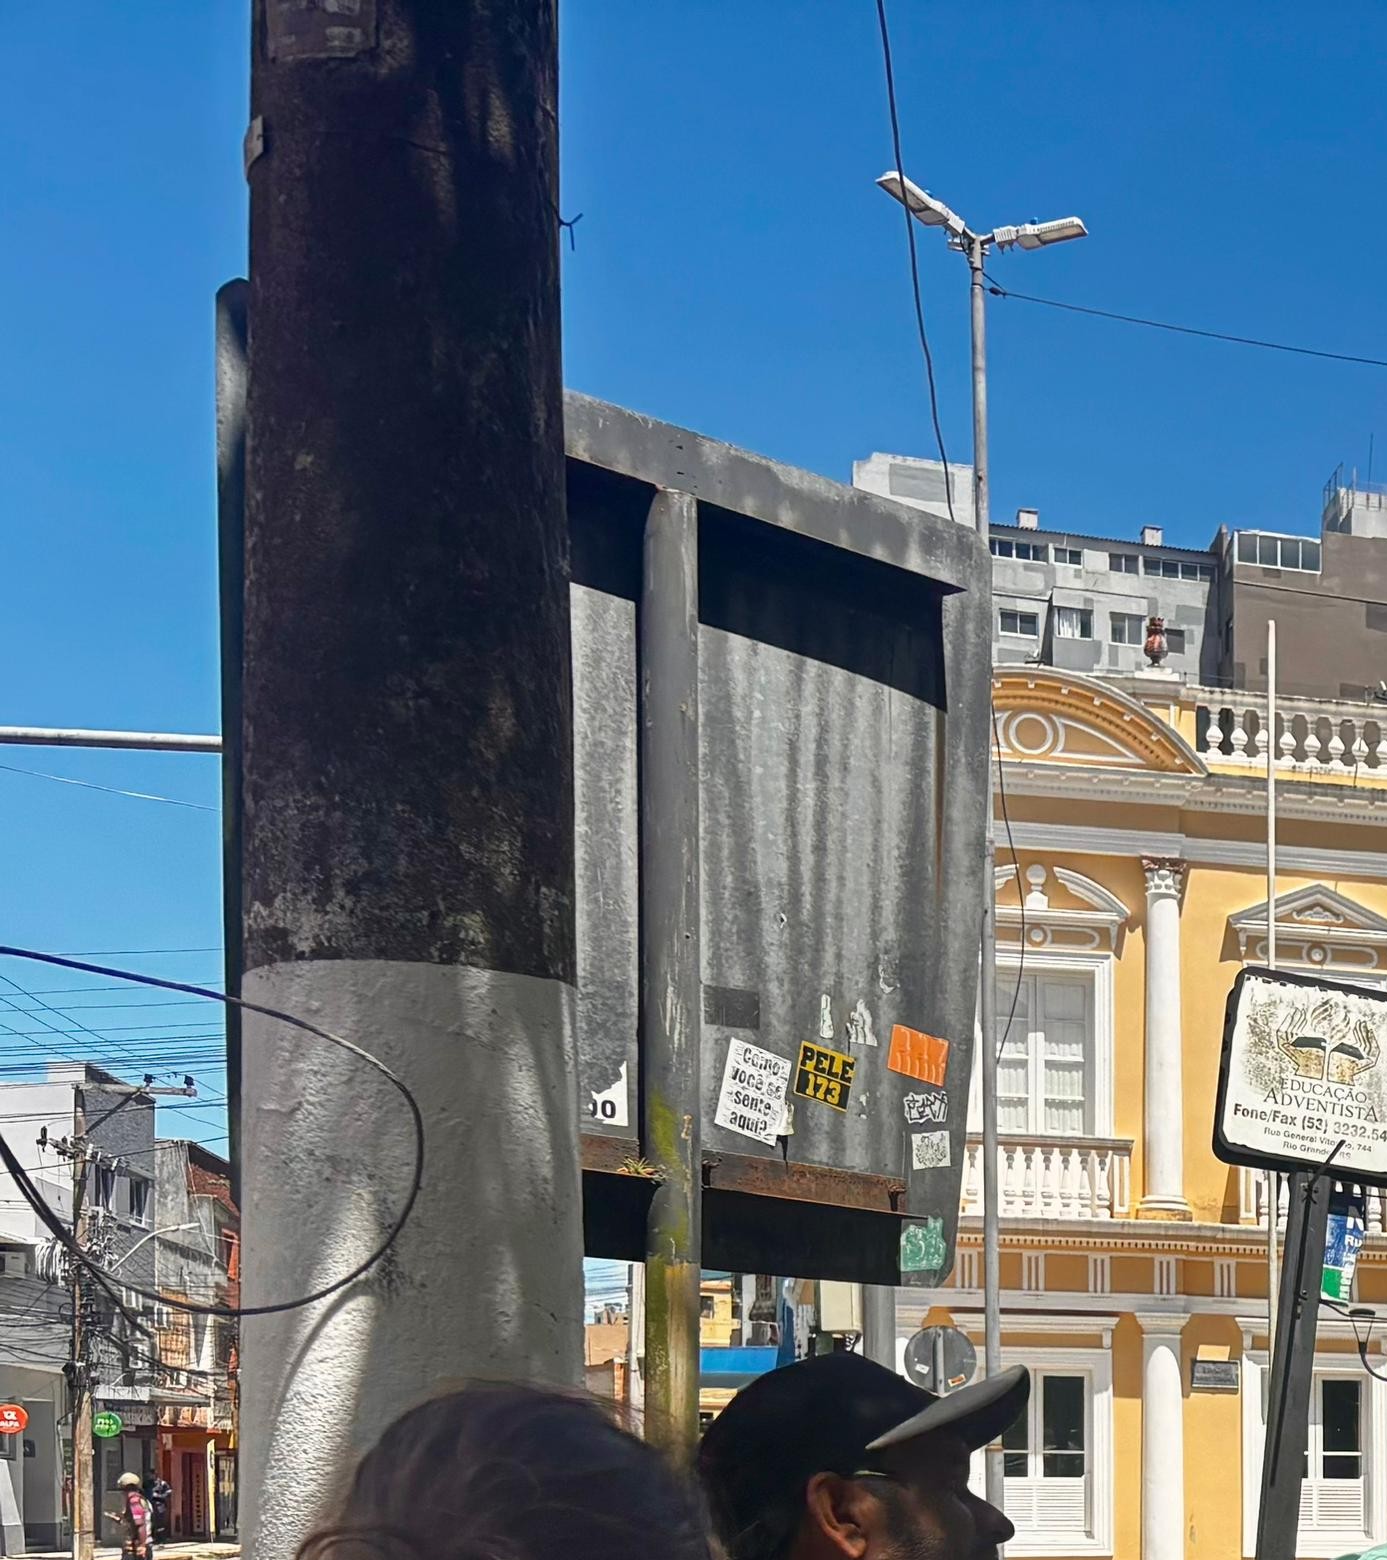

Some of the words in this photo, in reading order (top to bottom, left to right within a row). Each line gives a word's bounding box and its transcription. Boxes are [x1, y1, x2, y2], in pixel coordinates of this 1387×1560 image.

[801, 1046, 855, 1082] PELE
[732, 1067, 764, 1091] você
[806, 1073, 841, 1104] 173
[1281, 1079, 1368, 1104] EDUCAÇÃO
[733, 1090, 771, 1117] sente
[1263, 1088, 1379, 1123] ADVENTISTA
[1233, 1102, 1297, 1127] Fone/Fax
[1301, 1115, 1329, 1135] (53)
[1264, 1126, 1281, 1137] Rua
[1283, 1130, 1317, 1143] General
[1357, 1143, 1372, 1153] 744
[1283, 1140, 1297, 1151] Rio
